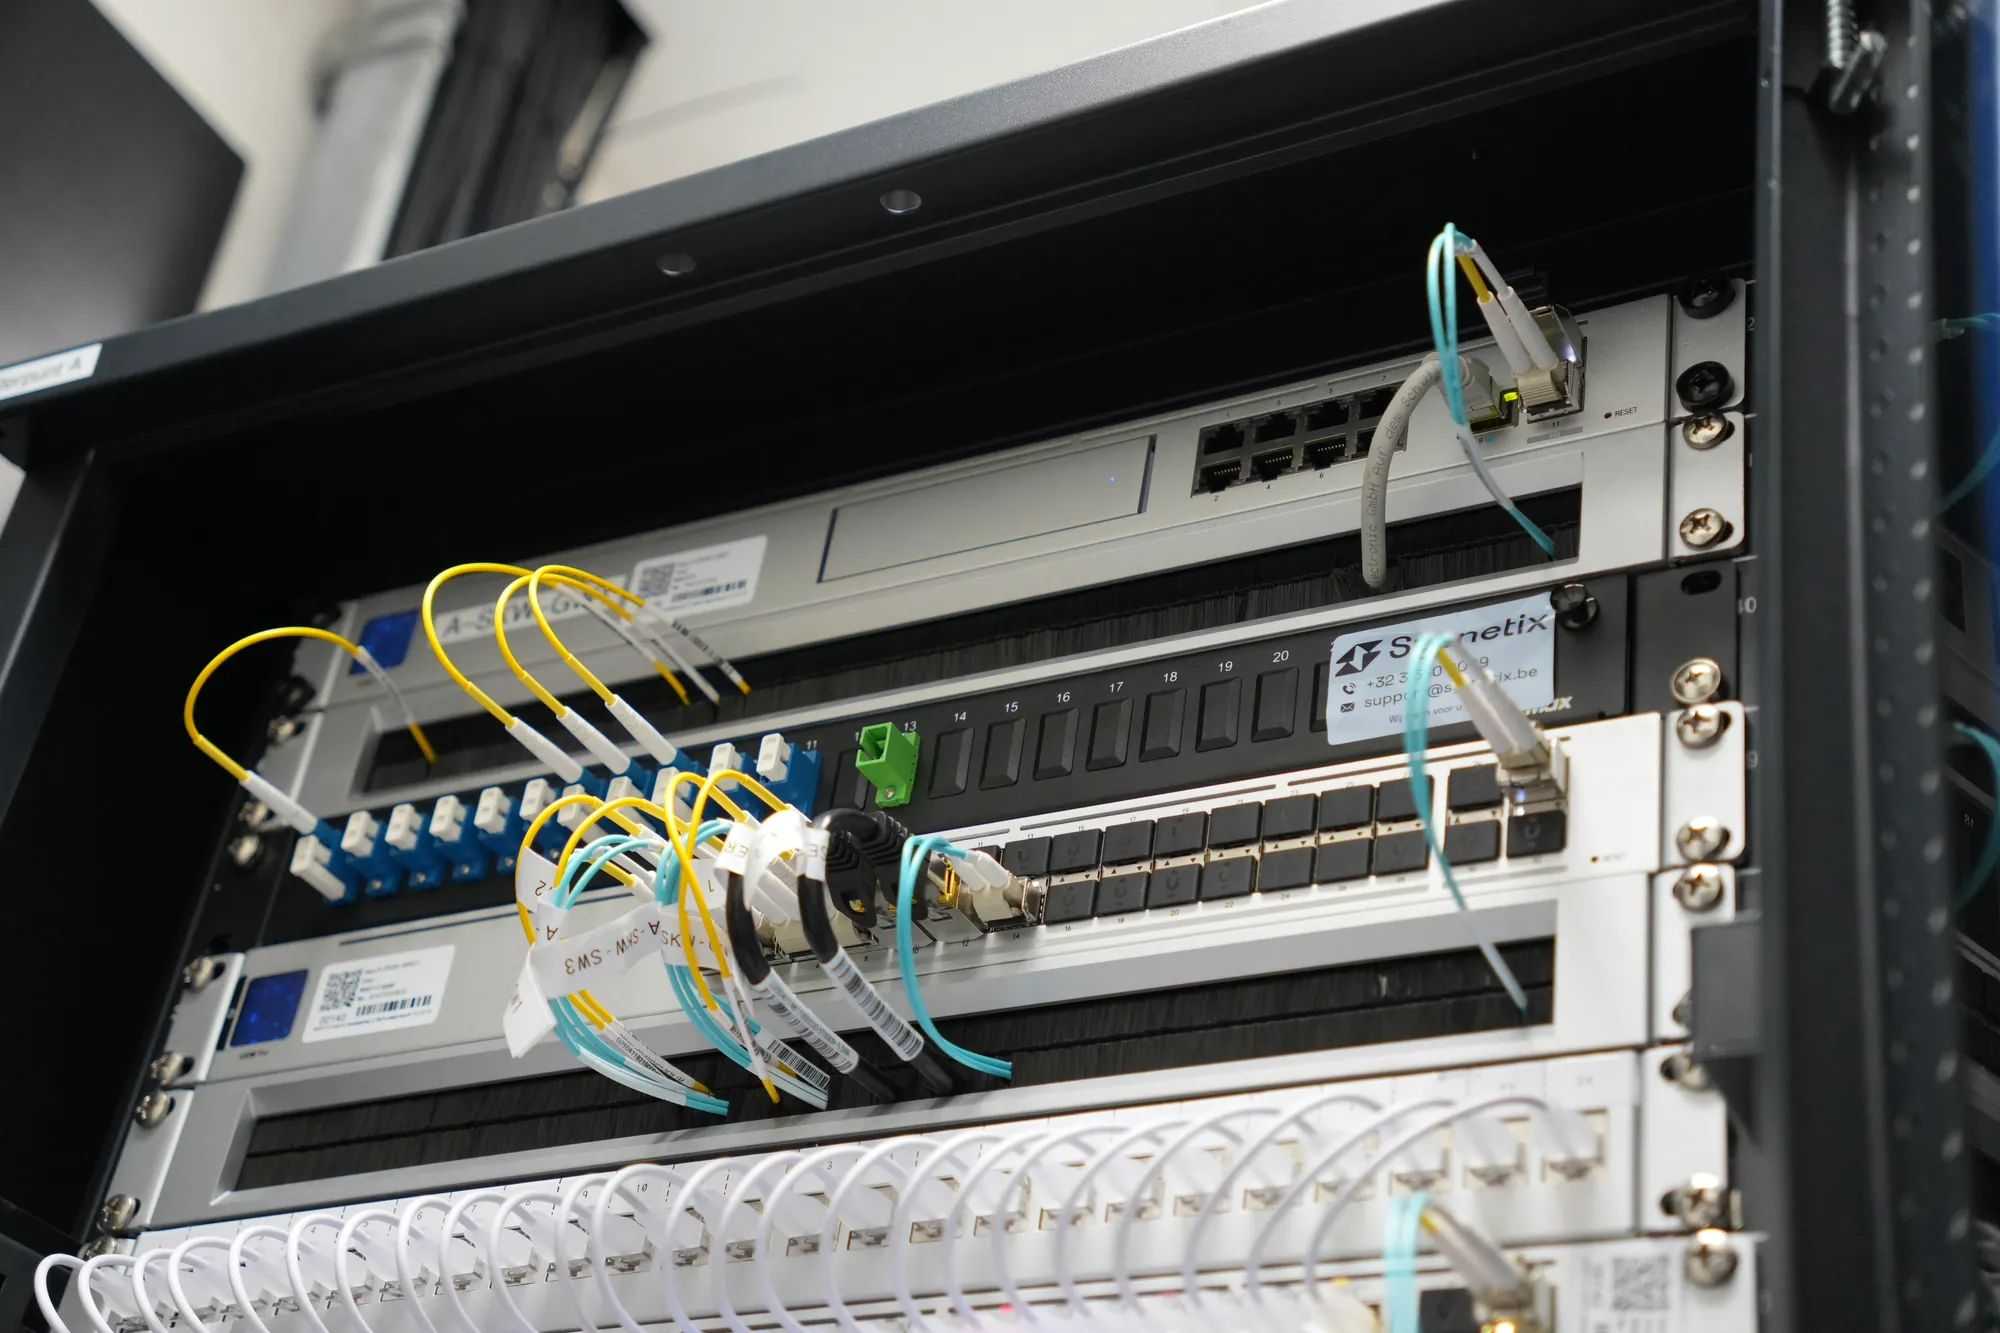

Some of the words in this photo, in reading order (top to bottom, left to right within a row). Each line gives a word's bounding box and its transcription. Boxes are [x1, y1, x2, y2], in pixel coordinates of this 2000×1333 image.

[1614, 406, 1638, 418] RESET
[1551, 420, 1560, 428] 11
[1366, 524, 1380, 588] lectronic
[1366, 674, 1395, 689] +32
[806, 740, 818, 751] 11
[903, 721, 917, 732] 13
[953, 711, 967, 722] 14
[1005, 701, 1019, 713] 15
[1056, 691, 1071, 703] 16
[1109, 681, 1124, 693] 17
[1162, 671, 1178, 683] 18
[1218, 661, 1233, 673] 19
[1272, 650, 1290, 663] 20
[1077, 824, 1085, 832] 15
[1012, 932, 1020, 940] 14
[1170, 909, 1180, 917] 20
[416, 1211, 422, 1221] 6
[471, 1204, 477, 1213] 7
[582, 1190, 588, 1199] 9
[636, 1183, 649, 1193] 10
